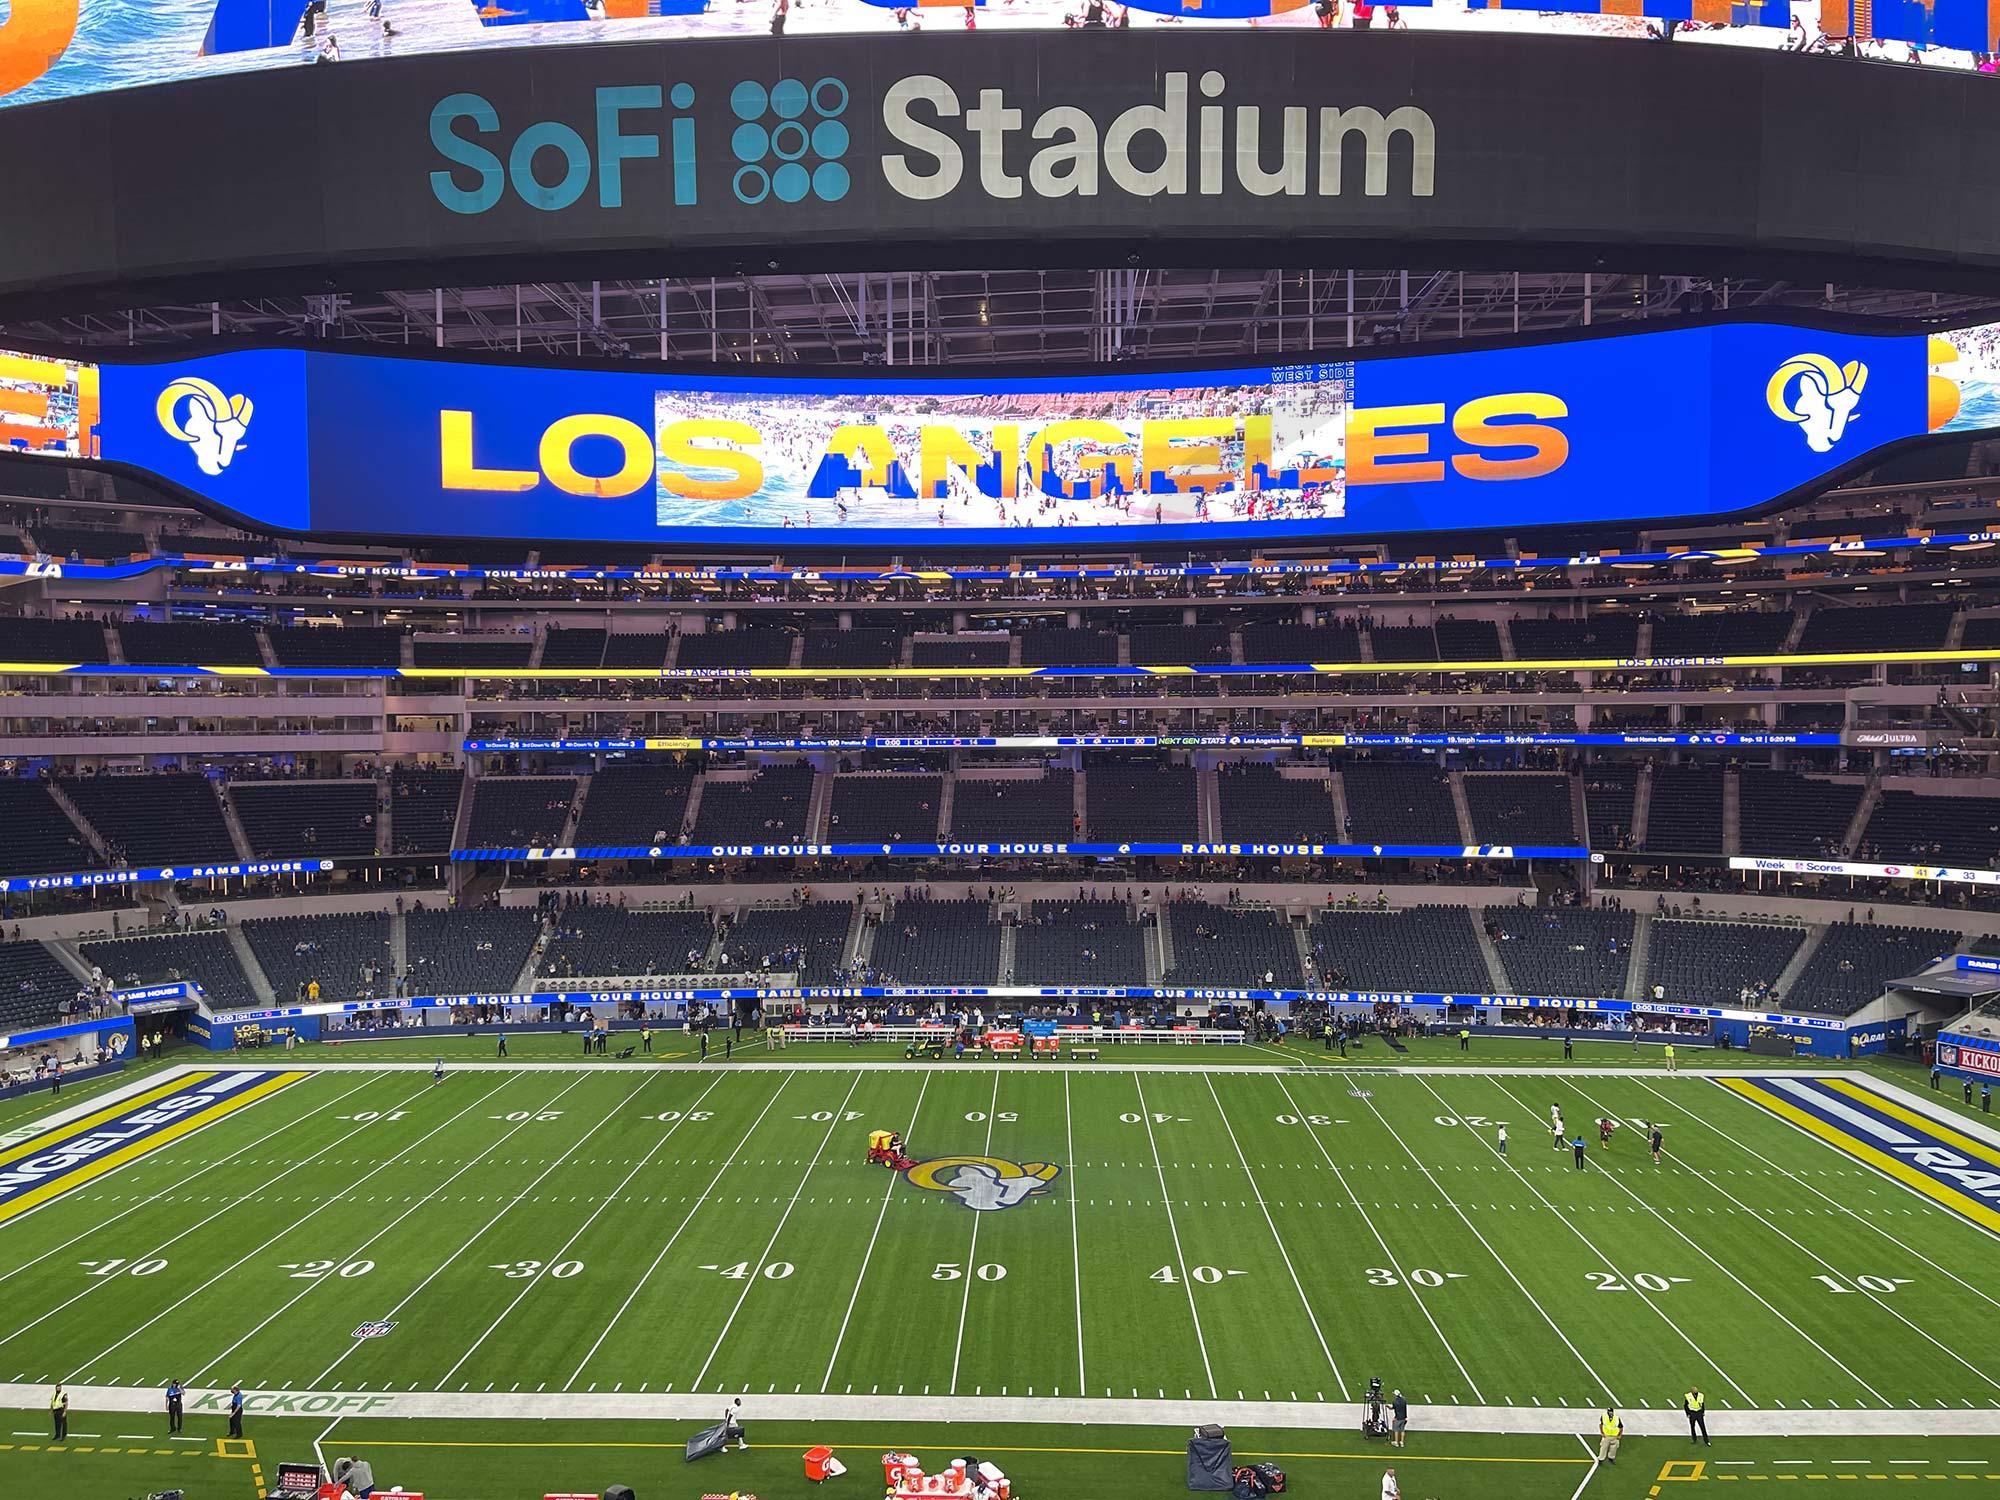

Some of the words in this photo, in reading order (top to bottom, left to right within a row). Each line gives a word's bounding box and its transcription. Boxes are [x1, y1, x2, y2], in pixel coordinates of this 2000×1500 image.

[430, 82, 696, 214] SoFi
[881, 71, 1436, 199] Stadium
[1272, 371, 1313, 382] WEST
[1319, 367, 1354, 379] SIDE
[440, 409, 763, 501] LOS
[806, 392, 1569, 501] ANGELES
[1441, 560, 1486, 568] HOUSE
[338, 566, 366, 575] OUR
[372, 567, 418, 576] HOUSE
[485, 570, 518, 579] YOUR
[524, 570, 566, 579] HOUSE
[633, 571, 669, 579] RAMS
[675, 571, 717, 579] HOUSE
[1616, 658, 1646, 667] LOS
[1651, 656, 1725, 667] ANGELES
[660, 668, 686, 677] LOS
[690, 668, 752, 677] ANGELES
[1158, 737, 1182, 745] NEXT
[1182, 737, 1200, 745] GEN
[1201, 737, 1227, 745] STATS
[1447, 736, 1476, 744] 19.1mph
[1740, 736, 1755, 744] Sep.
[1889, 734, 1917, 743] ULTRA
[526, 848, 576, 860] LA
[711, 845, 753, 855] OUR
[763, 844, 833, 855] HOUSE
[937, 844, 989, 854] YOUR
[1000, 844, 1068, 854] HOUSE
[1182, 844, 1242, 854] RAMS
[1253, 844, 1324, 855] HOUSE
[1463, 846, 1514, 858] LA
[193, 866, 241, 877] RAMS
[248, 862, 302, 874] HOUSE
[1756, 859, 1785, 870] Week
[1806, 862, 1843, 874] Scores
[1917, 868, 1928, 877] 41
[1963, 871, 1976, 880] 33
[29, 878, 73, 889] YOUR
[82, 871, 139, 884] HOUSE
[1968, 959, 1997, 970] RAMS
[148, 987, 179, 999] HOUSE
[590, 993, 631, 1002] YOUR
[641, 992, 695, 1001] HOUSE
[756, 989, 802, 999] RAMS
[810, 988, 863, 997] HOUSE
[1154, 989, 1185, 998] OUR
[1193, 990, 1249, 999] HOUSE
[1306, 992, 1349, 1002] YOUR
[1358, 993, 1414, 1004] HOUSE
[435, 997, 469, 1006] OUR
[476, 996, 533, 1005] HOUSE
[1480, 997, 1530, 1007] RAMS
[1539, 998, 1598, 1009] HOUSE
[234, 1023, 260, 1033] LOS
[357, 1328, 384, 1336] NFL
[189, 1391, 394, 1415] KICKOFF
[890, 1467, 903, 1479] G
